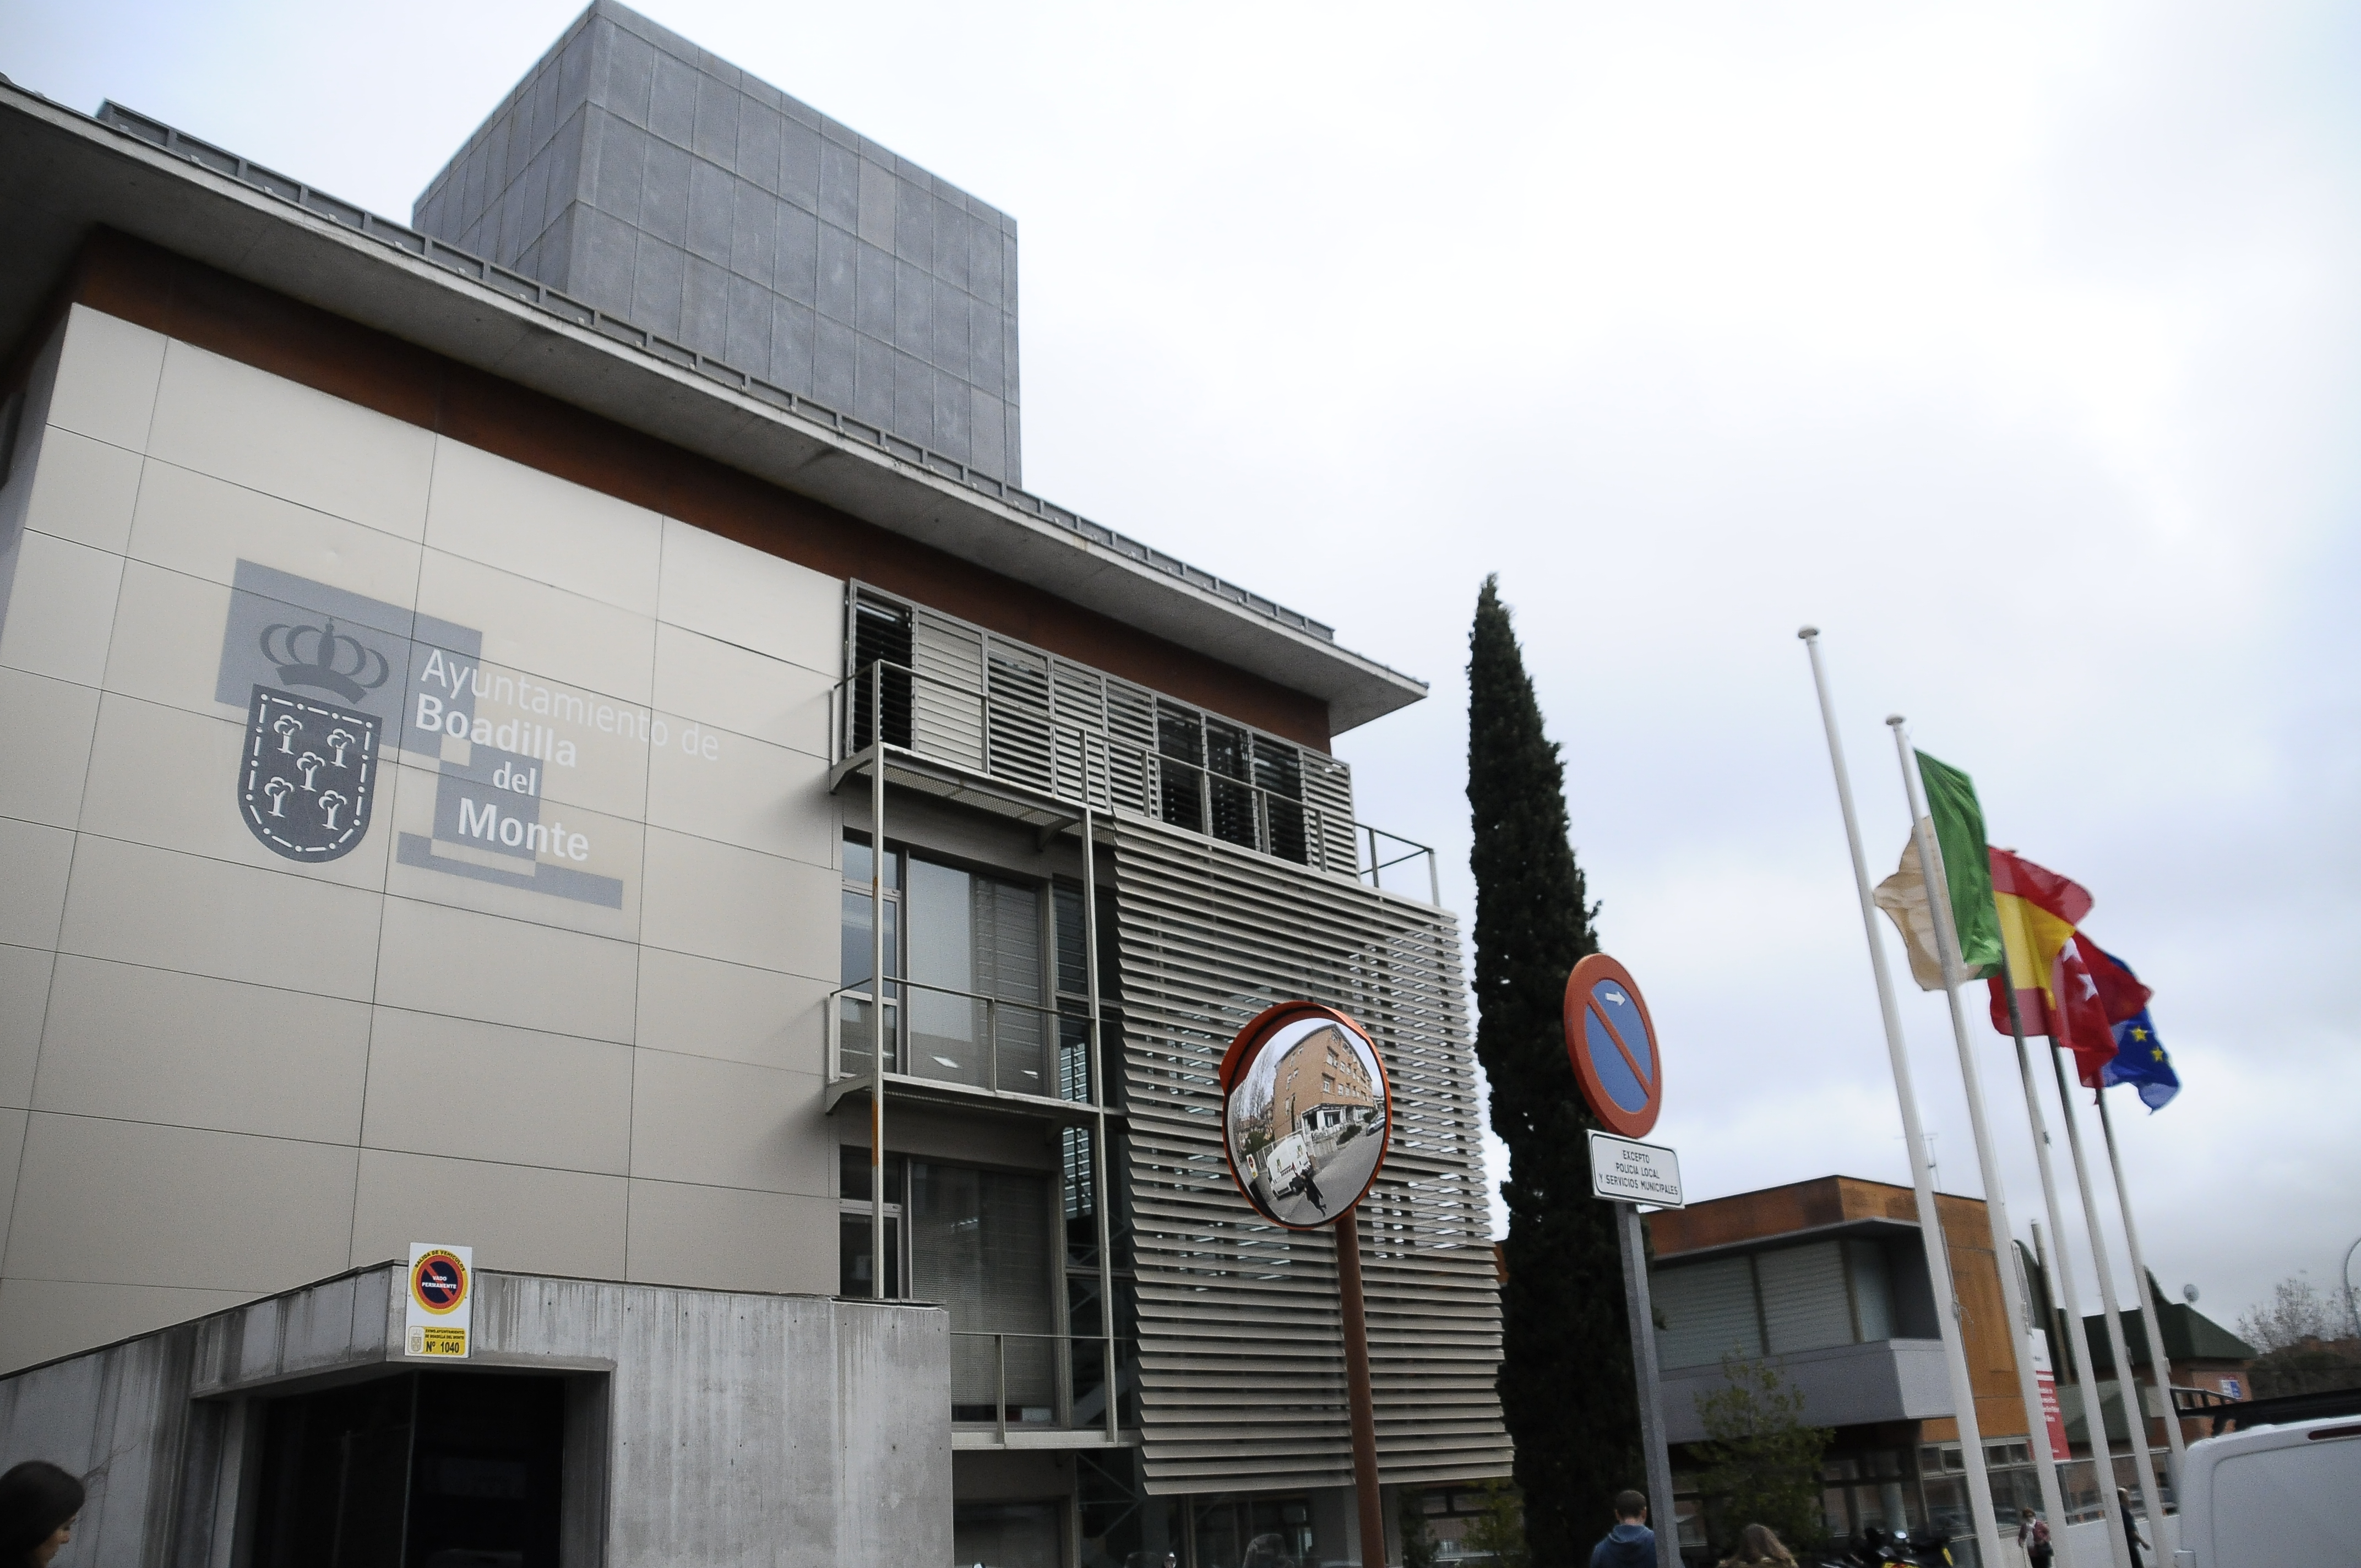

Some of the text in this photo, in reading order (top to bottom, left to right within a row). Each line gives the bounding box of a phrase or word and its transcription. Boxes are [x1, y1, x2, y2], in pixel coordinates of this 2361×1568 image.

[421, 649, 719, 761] Ayuntamiento de
[416, 692, 576, 768] Boadilla
[493, 761, 536, 796] del
[458, 797, 589, 862] Monte
[1623, 1150, 1650, 1163] EXCEPTO
[1615, 1163, 1660, 1179] POLICIA LOCAL
[1599, 1173, 1678, 1195] Y SERVICIOS MUNICIPALES
[415, 1252, 431, 1268] SALIDA
[440, 1341, 460, 1353] 1040
